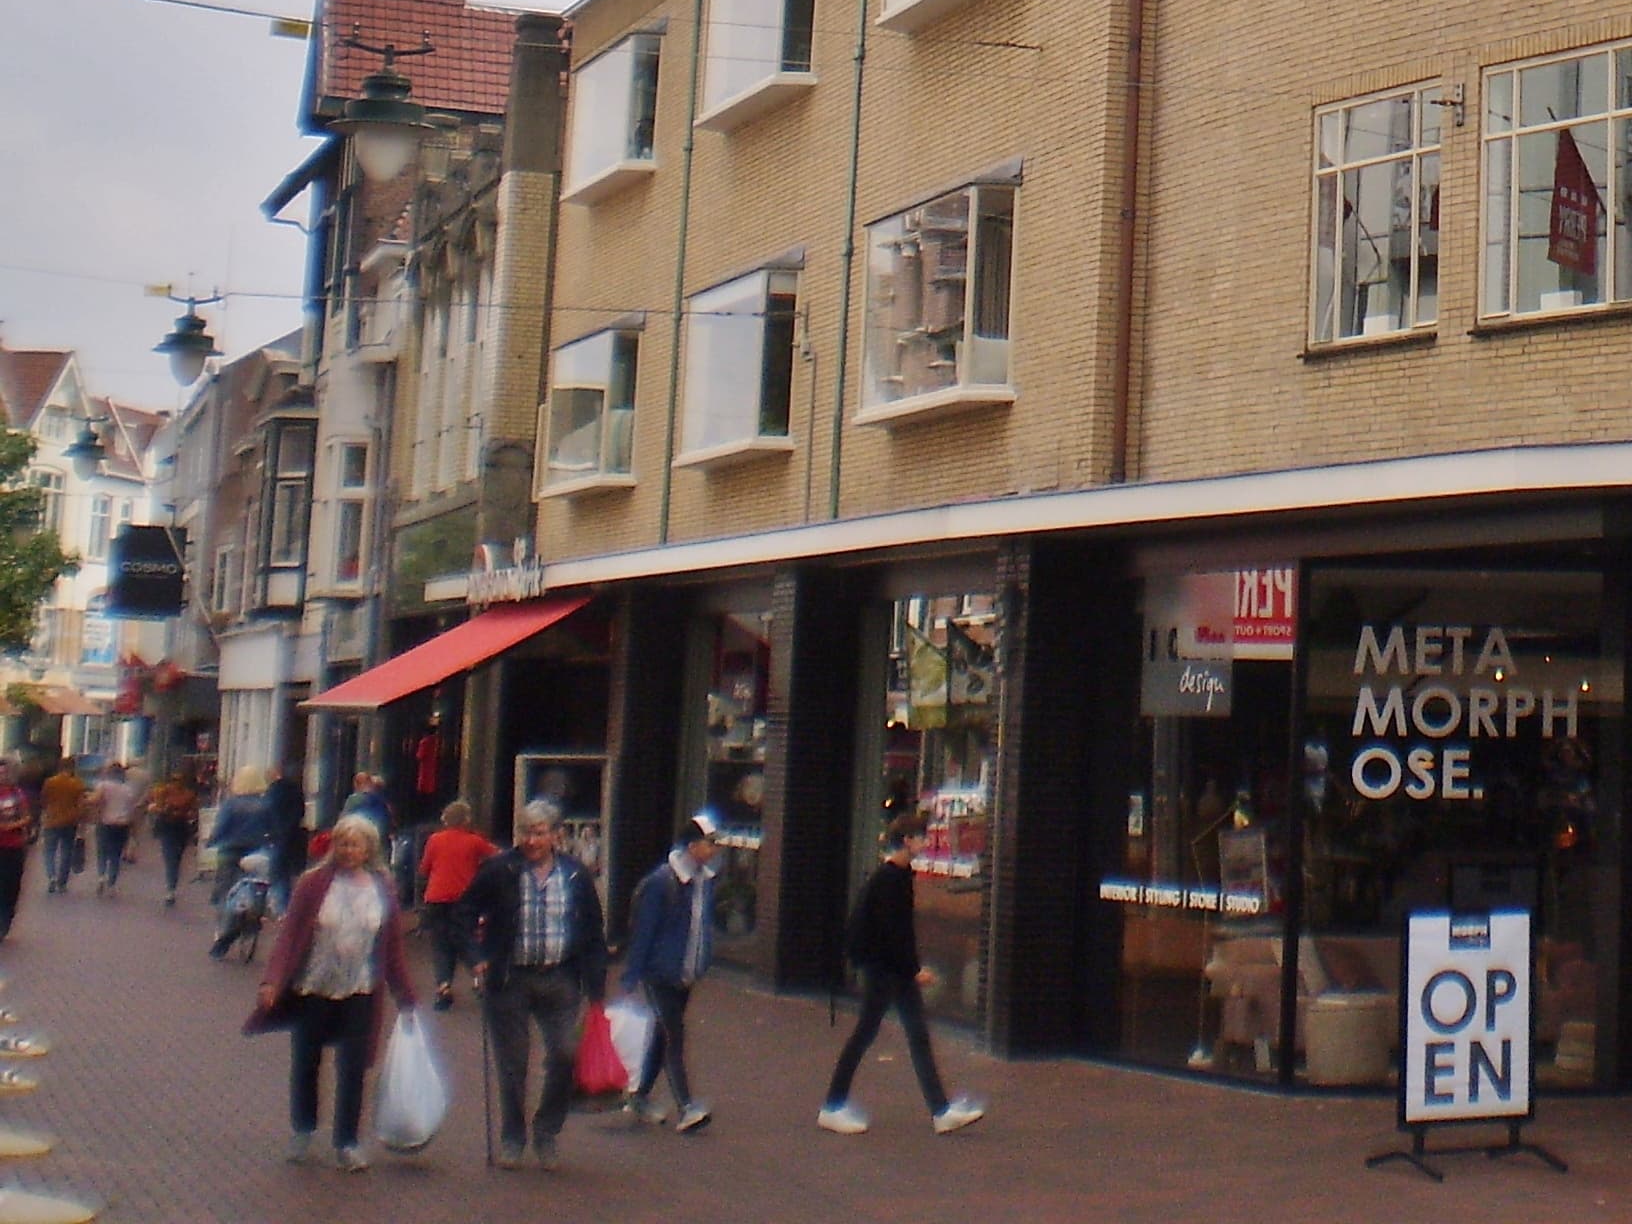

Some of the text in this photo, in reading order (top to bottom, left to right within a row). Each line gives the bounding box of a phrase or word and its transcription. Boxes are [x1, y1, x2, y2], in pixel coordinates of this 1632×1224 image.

[1353, 626, 1518, 675] META
[1179, 665, 1225, 712] design
[1352, 686, 1578, 738] MORPH
[1352, 746, 1484, 800] OSE.
[1420, 969, 1517, 1035] OP
[1424, 1039, 1511, 1106] EN
